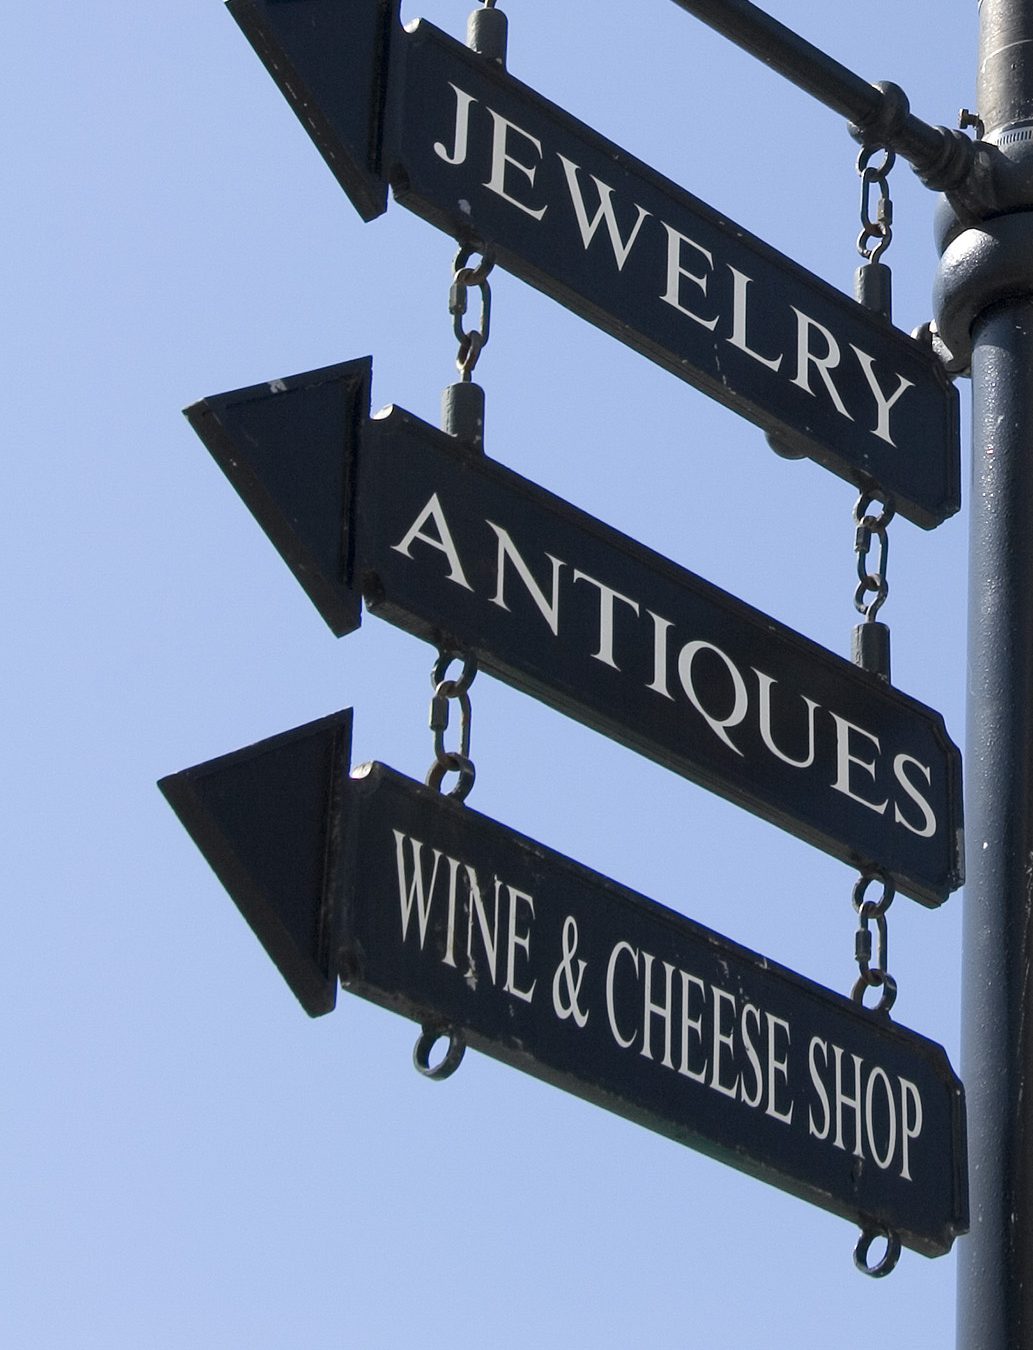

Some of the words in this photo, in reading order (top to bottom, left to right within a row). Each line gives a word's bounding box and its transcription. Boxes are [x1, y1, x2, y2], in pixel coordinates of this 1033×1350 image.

[434, 82, 915, 448] JEWELRY
[390, 492, 938, 838] ANTIQUES
[392, 829, 537, 1003] WINE
[552, 915, 589, 1028] &
[605, 941, 794, 1125] CHEESE
[808, 1036, 923, 1181] SHOP
